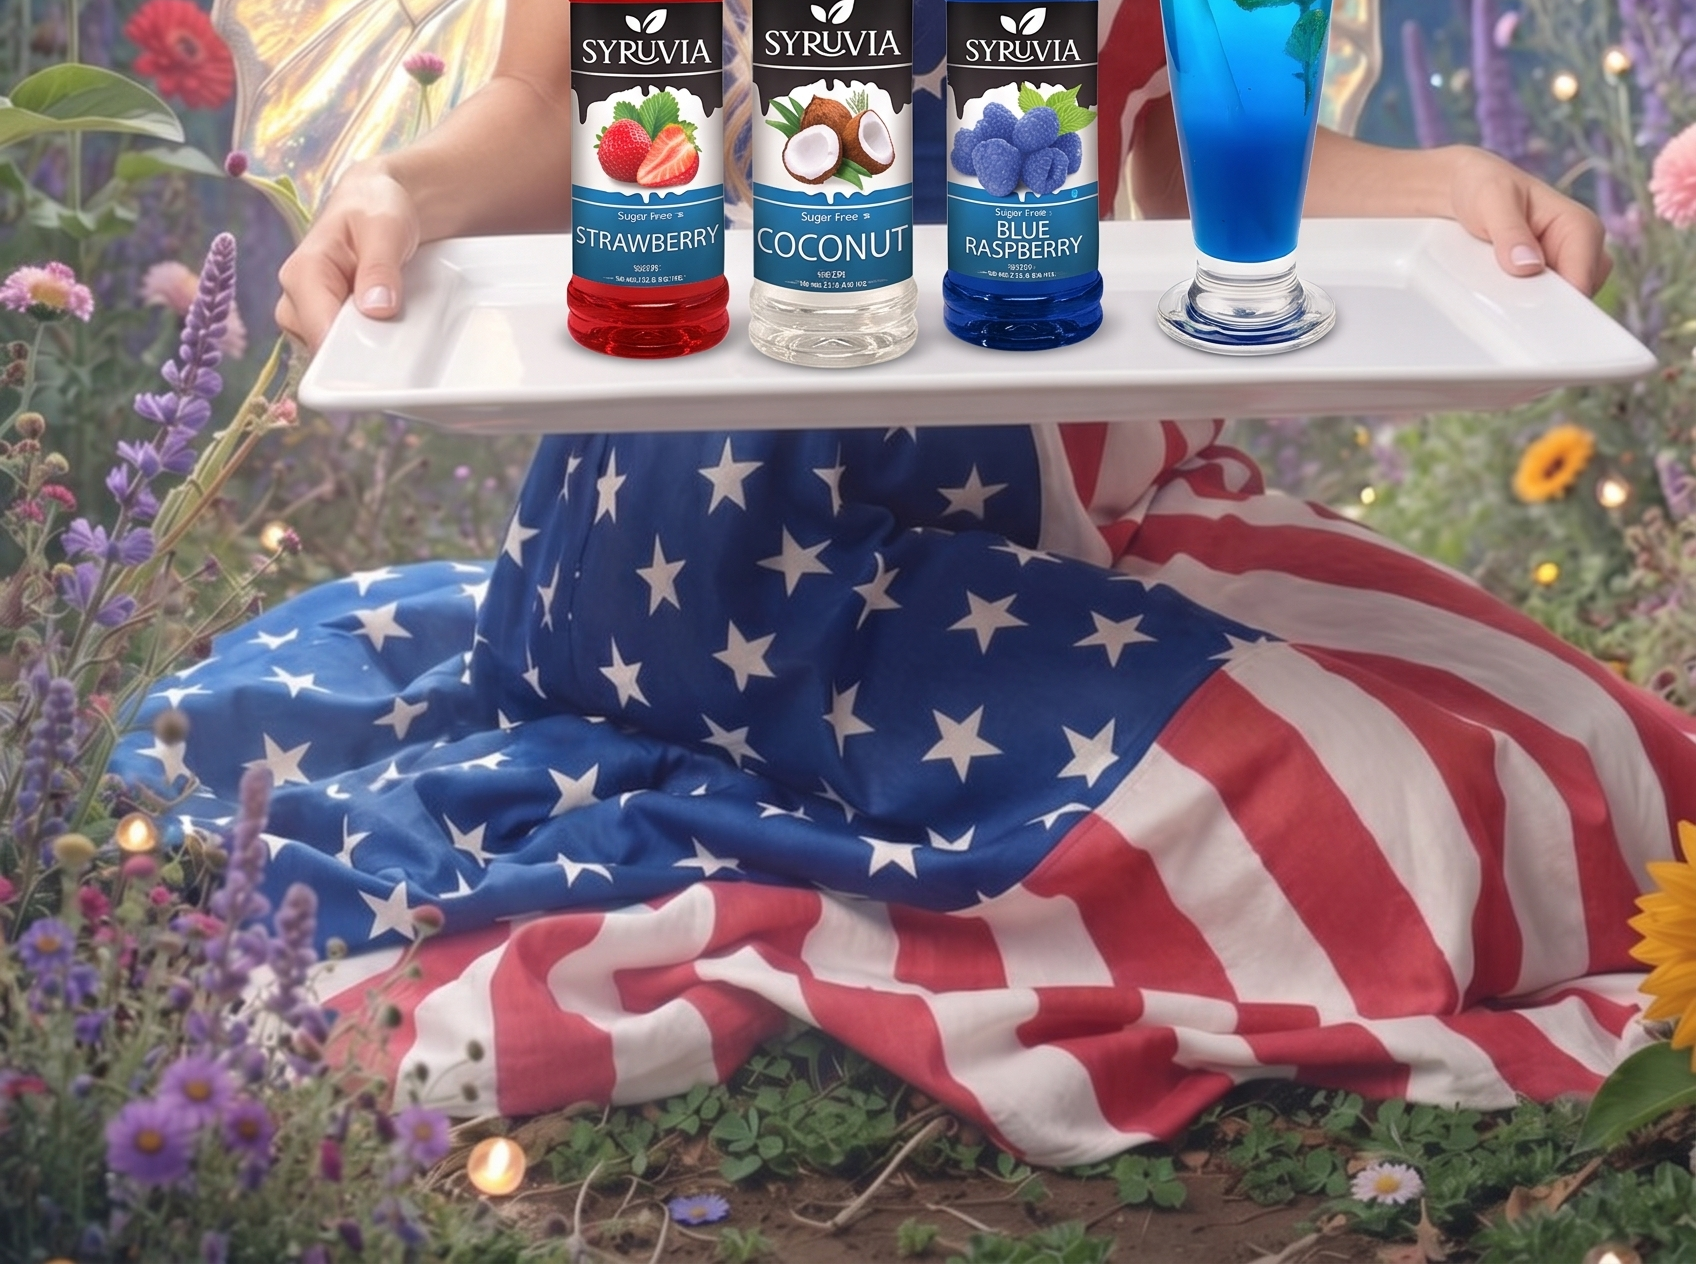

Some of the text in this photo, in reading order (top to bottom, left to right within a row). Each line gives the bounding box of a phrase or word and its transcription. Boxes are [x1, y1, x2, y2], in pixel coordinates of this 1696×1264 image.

[583, 39, 712, 65] SYRUVIA
[765, 30, 901, 57] SYRUVIA
[966, 39, 1081, 63] SYRUVIA
[835, 213, 859, 222] Free
[997, 220, 1050, 239] BLUE
[576, 224, 719, 253] STRAWBERRY
[757, 224, 909, 262] COCONUT
[965, 235, 1083, 259] RASPBERRY
